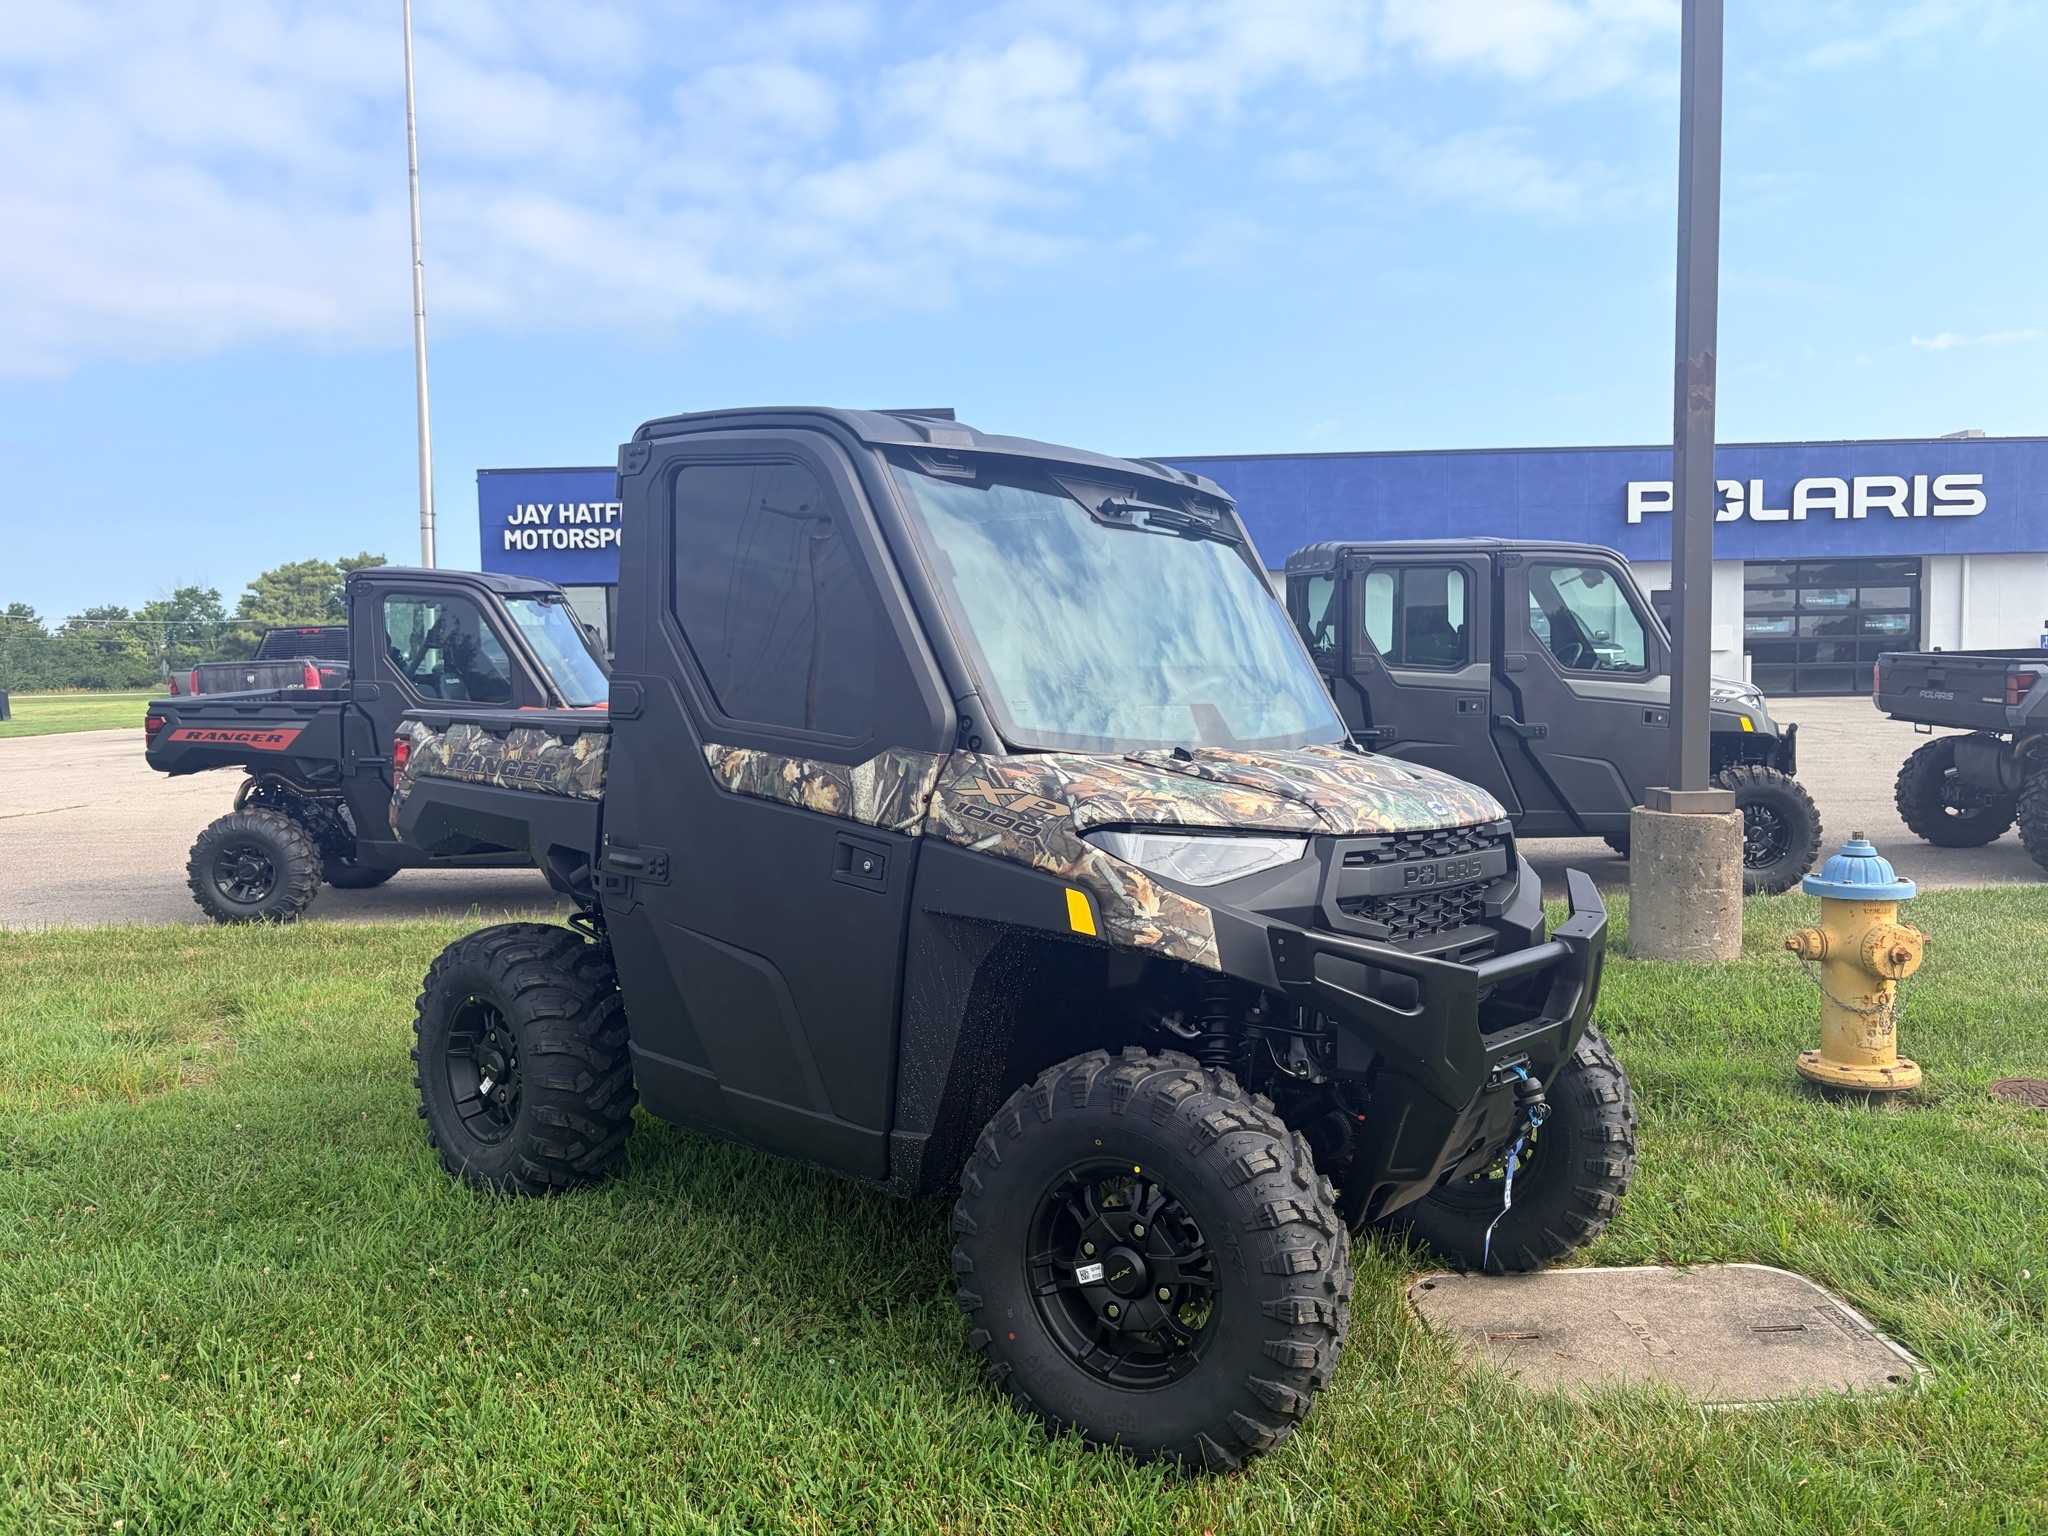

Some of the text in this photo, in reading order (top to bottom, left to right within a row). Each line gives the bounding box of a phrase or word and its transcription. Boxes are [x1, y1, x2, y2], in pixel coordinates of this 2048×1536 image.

[1627, 474, 1988, 523] POLARIS
[508, 504, 553, 525] JAY
[1920, 690, 1954, 700] POLARIS
[185, 731, 284, 743] RANGER
[446, 752, 558, 783] RANGER
[948, 776, 1072, 817] XP
[952, 801, 1043, 838] 1000
[1404, 857, 1482, 888] POLARIS
[1626, 1321, 1656, 1342] AT&T
